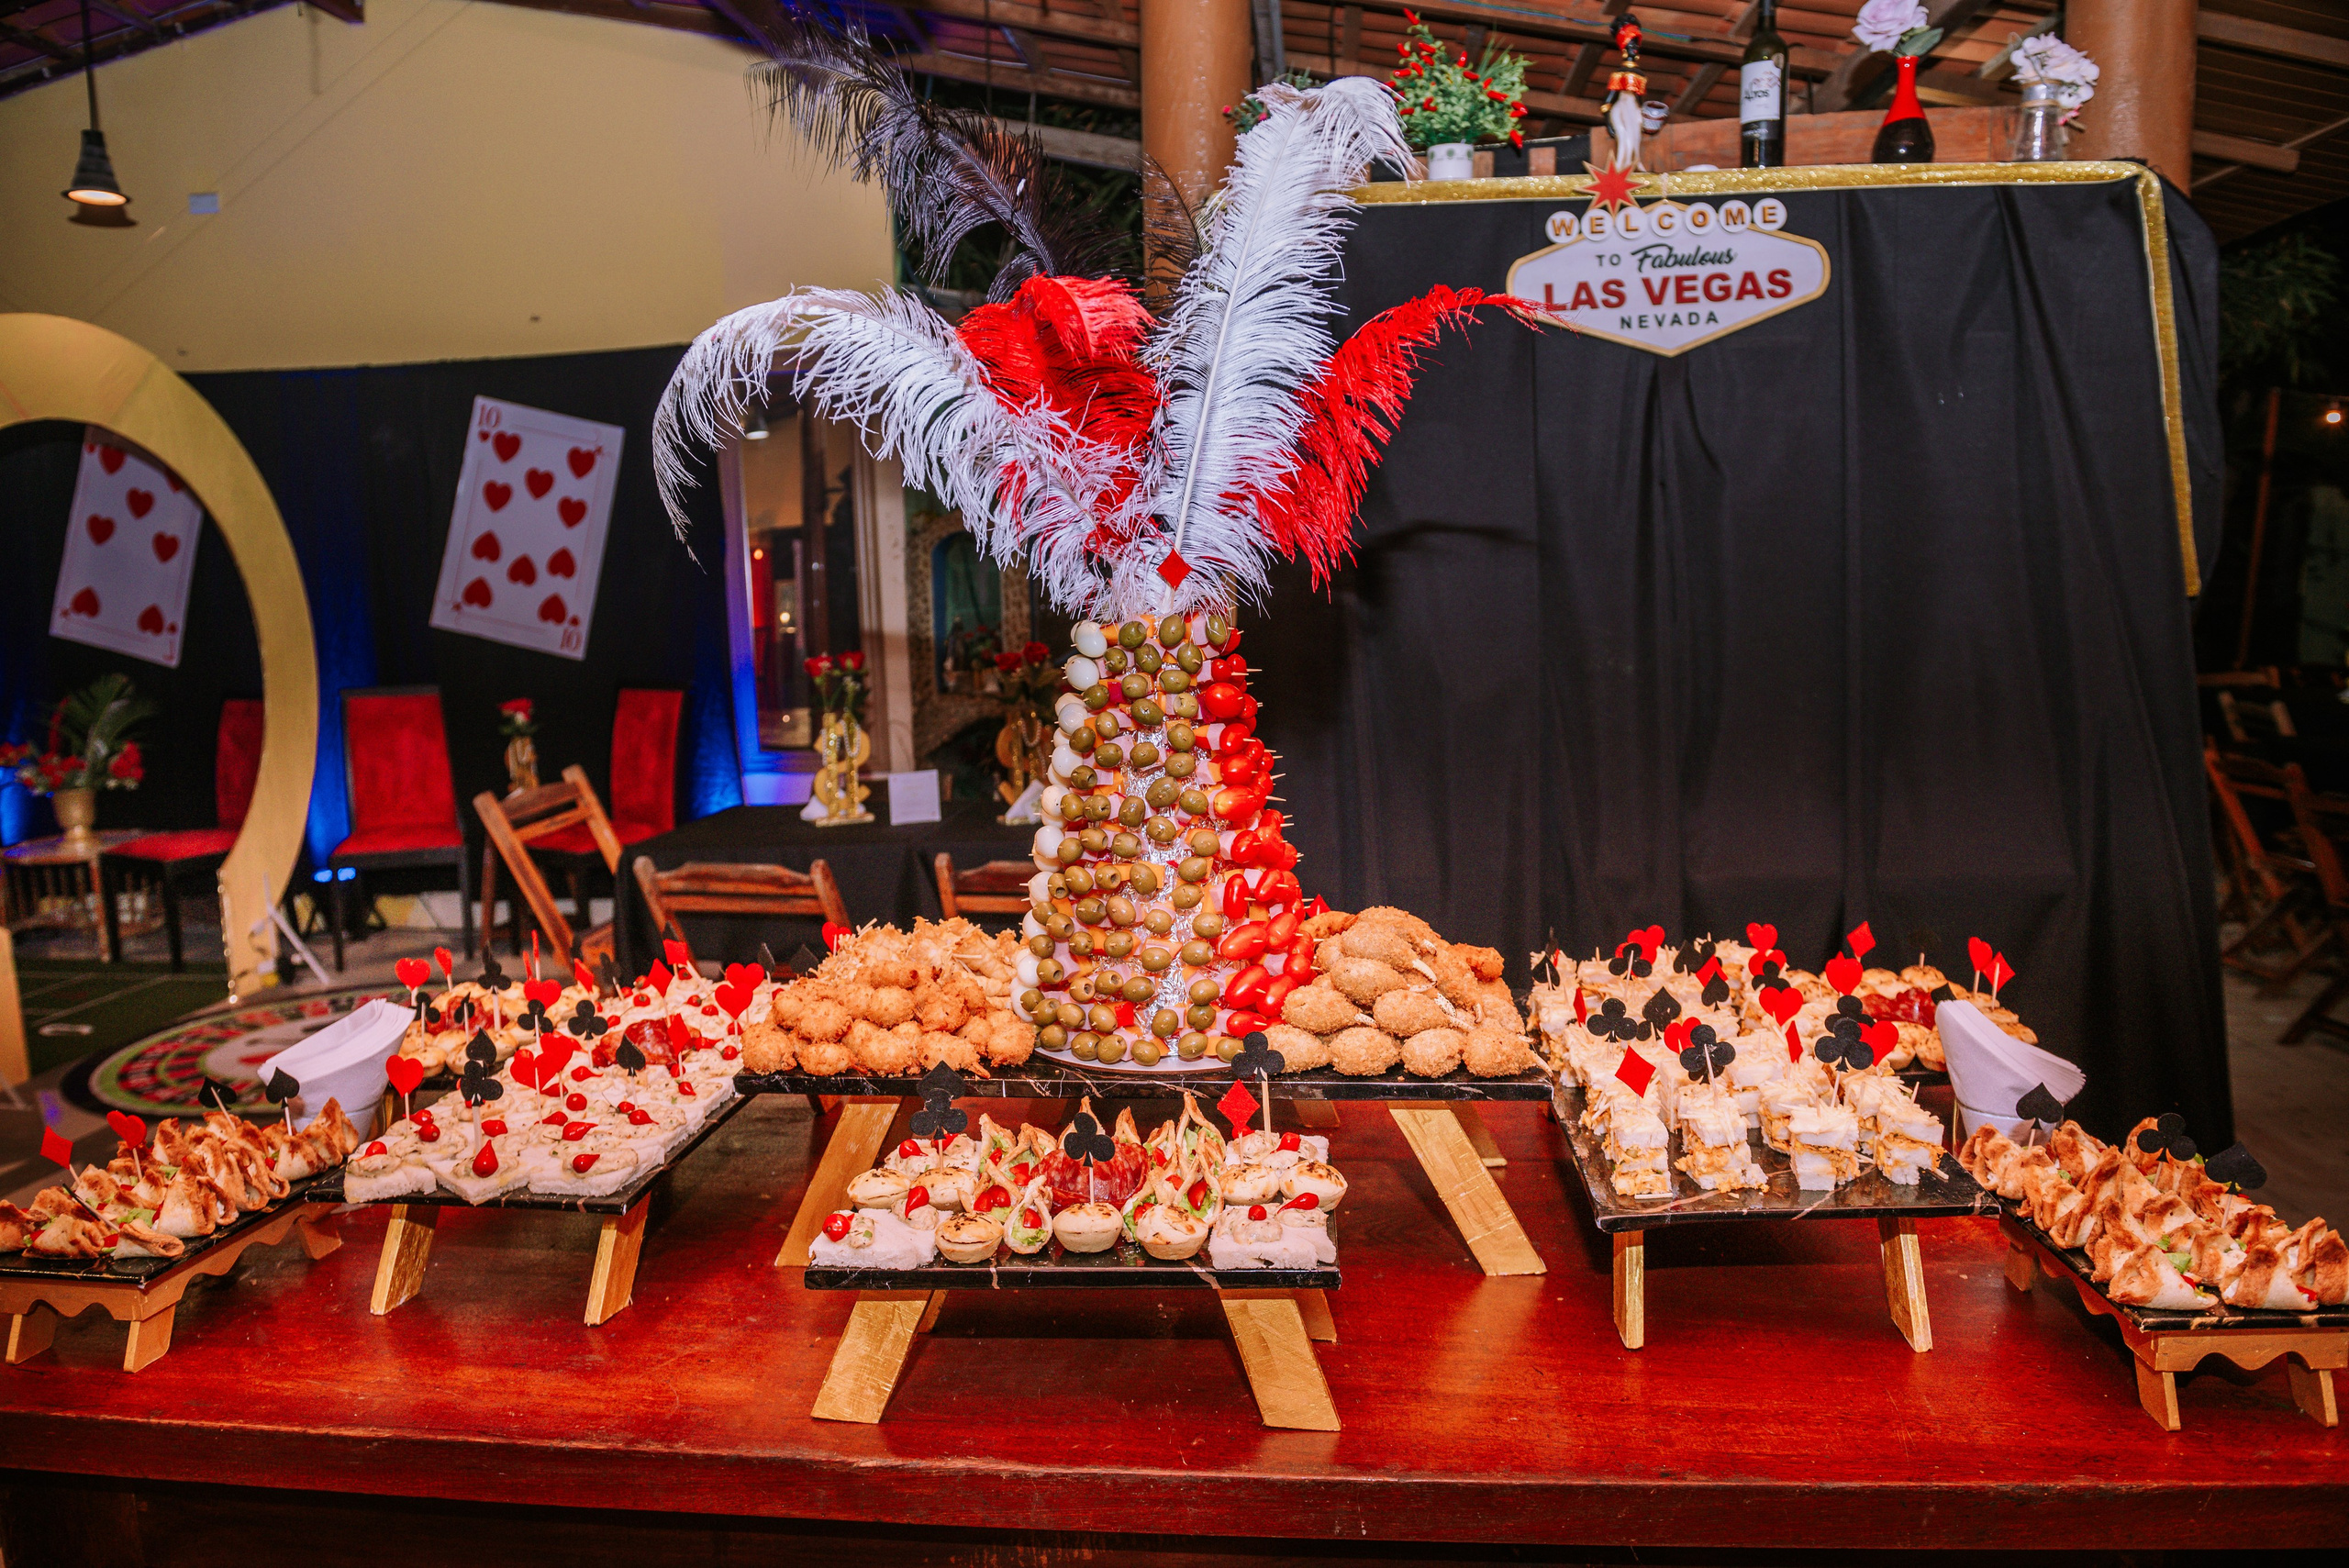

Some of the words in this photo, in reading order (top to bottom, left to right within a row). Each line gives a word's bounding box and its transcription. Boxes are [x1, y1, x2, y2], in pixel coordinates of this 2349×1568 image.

[1552, 205, 1778, 236] WELCOME
[1596, 254, 1621, 267] TO
[1631, 243, 1736, 273] Fabulous
[1543, 279, 1628, 311] LAS
[1642, 268, 1794, 306] VEGAS
[1620, 311, 1720, 329] NEVADA
[477, 404, 502, 428] 10
